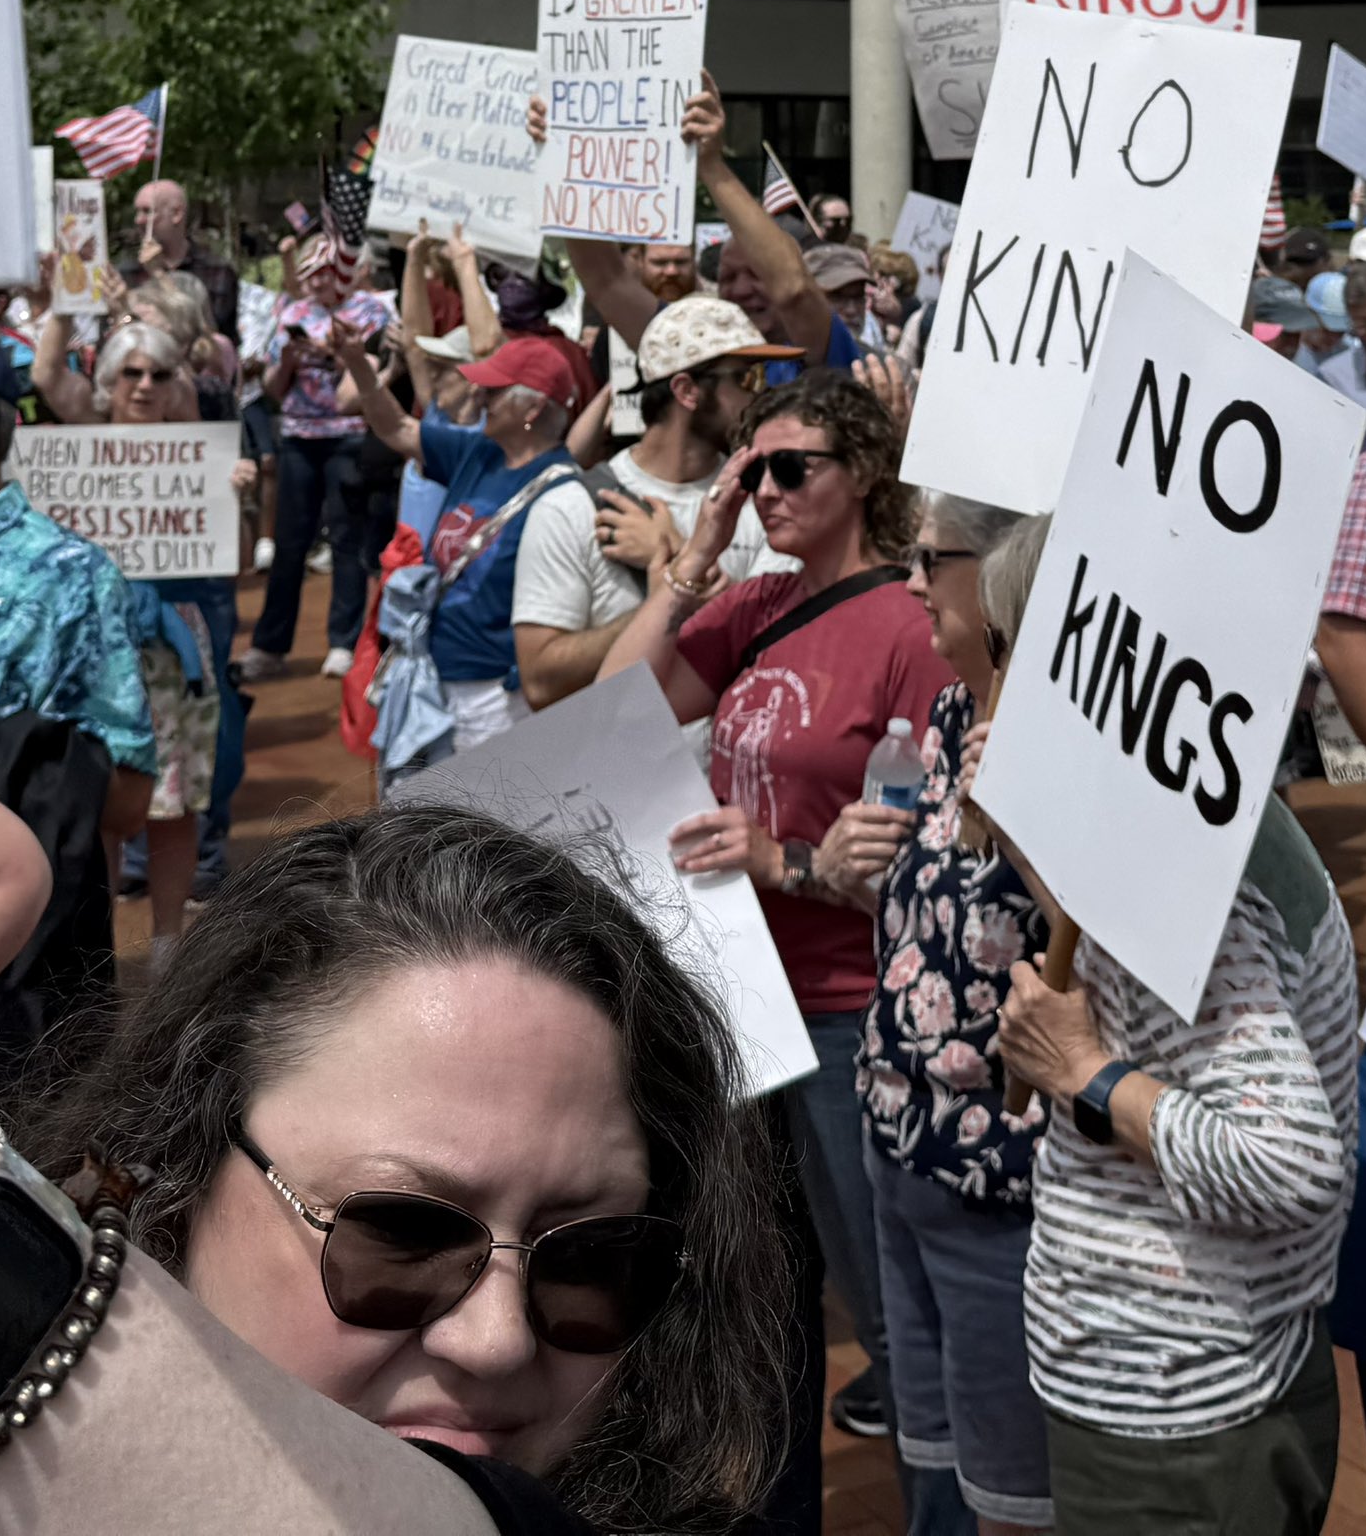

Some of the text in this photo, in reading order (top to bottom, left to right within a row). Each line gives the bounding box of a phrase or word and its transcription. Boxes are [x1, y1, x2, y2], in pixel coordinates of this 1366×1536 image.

[543, 27, 662, 72] THAN THE
[552, 77, 693, 128] PEOPLE IN
[1025, 58, 1192, 188] NO
[567, 135, 671, 185] POWER!
[543, 184, 578, 226] NO
[588, 185, 681, 241] KINGS!
[953, 230, 1114, 372] KIN
[12, 437, 207, 467] WHEN INJUSTICE
[1115, 357, 1282, 534] NO
[28, 470, 205, 503] BECOMES LAW
[48, 505, 208, 540] RESISTANCE
[155, 539, 217, 572] DUTY
[1049, 553, 1255, 827] KINGS
